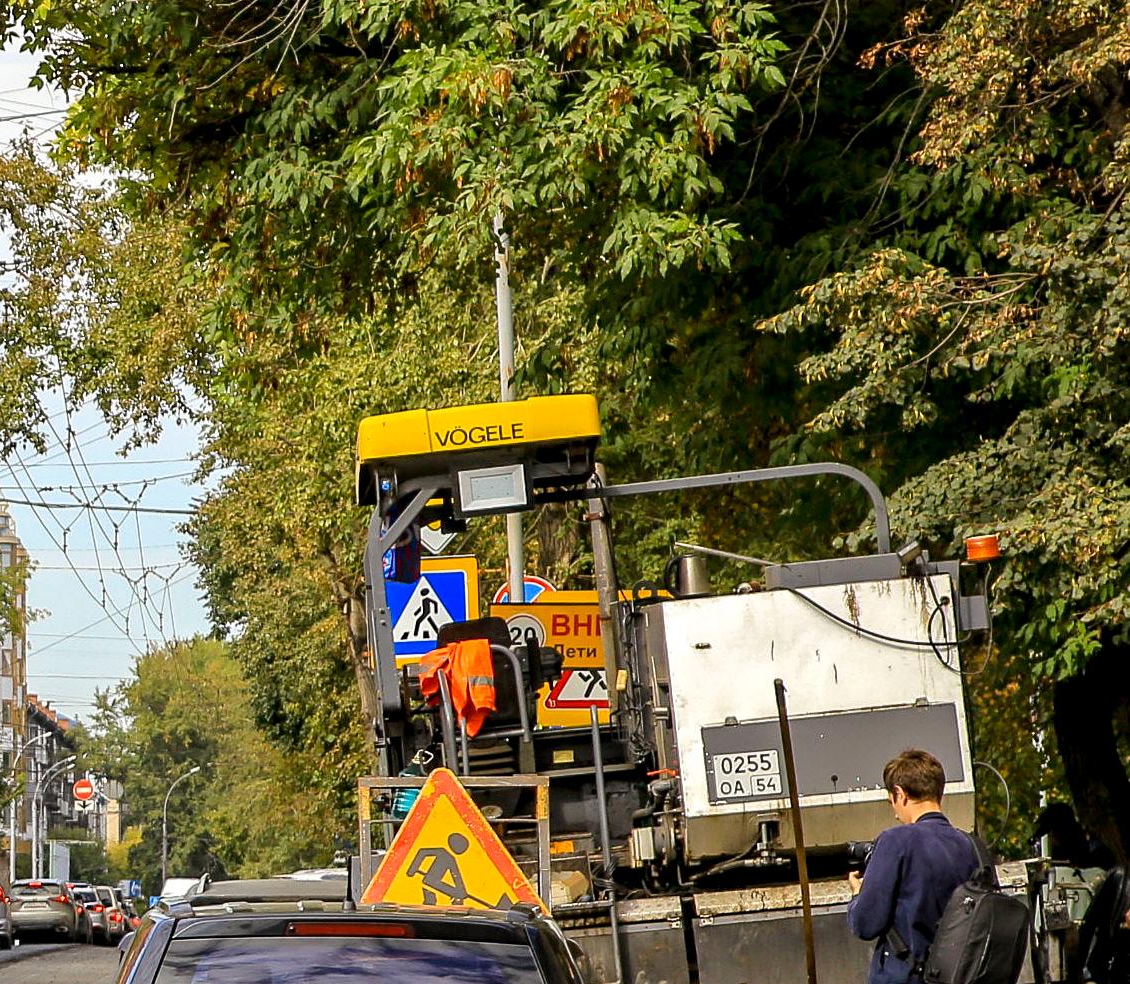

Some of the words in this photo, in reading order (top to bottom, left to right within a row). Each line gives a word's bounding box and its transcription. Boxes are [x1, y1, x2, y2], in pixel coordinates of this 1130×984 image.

[435, 423, 525, 446] VÖGELE
[721, 754, 772, 775] 0255
[756, 778, 776, 792] 54
